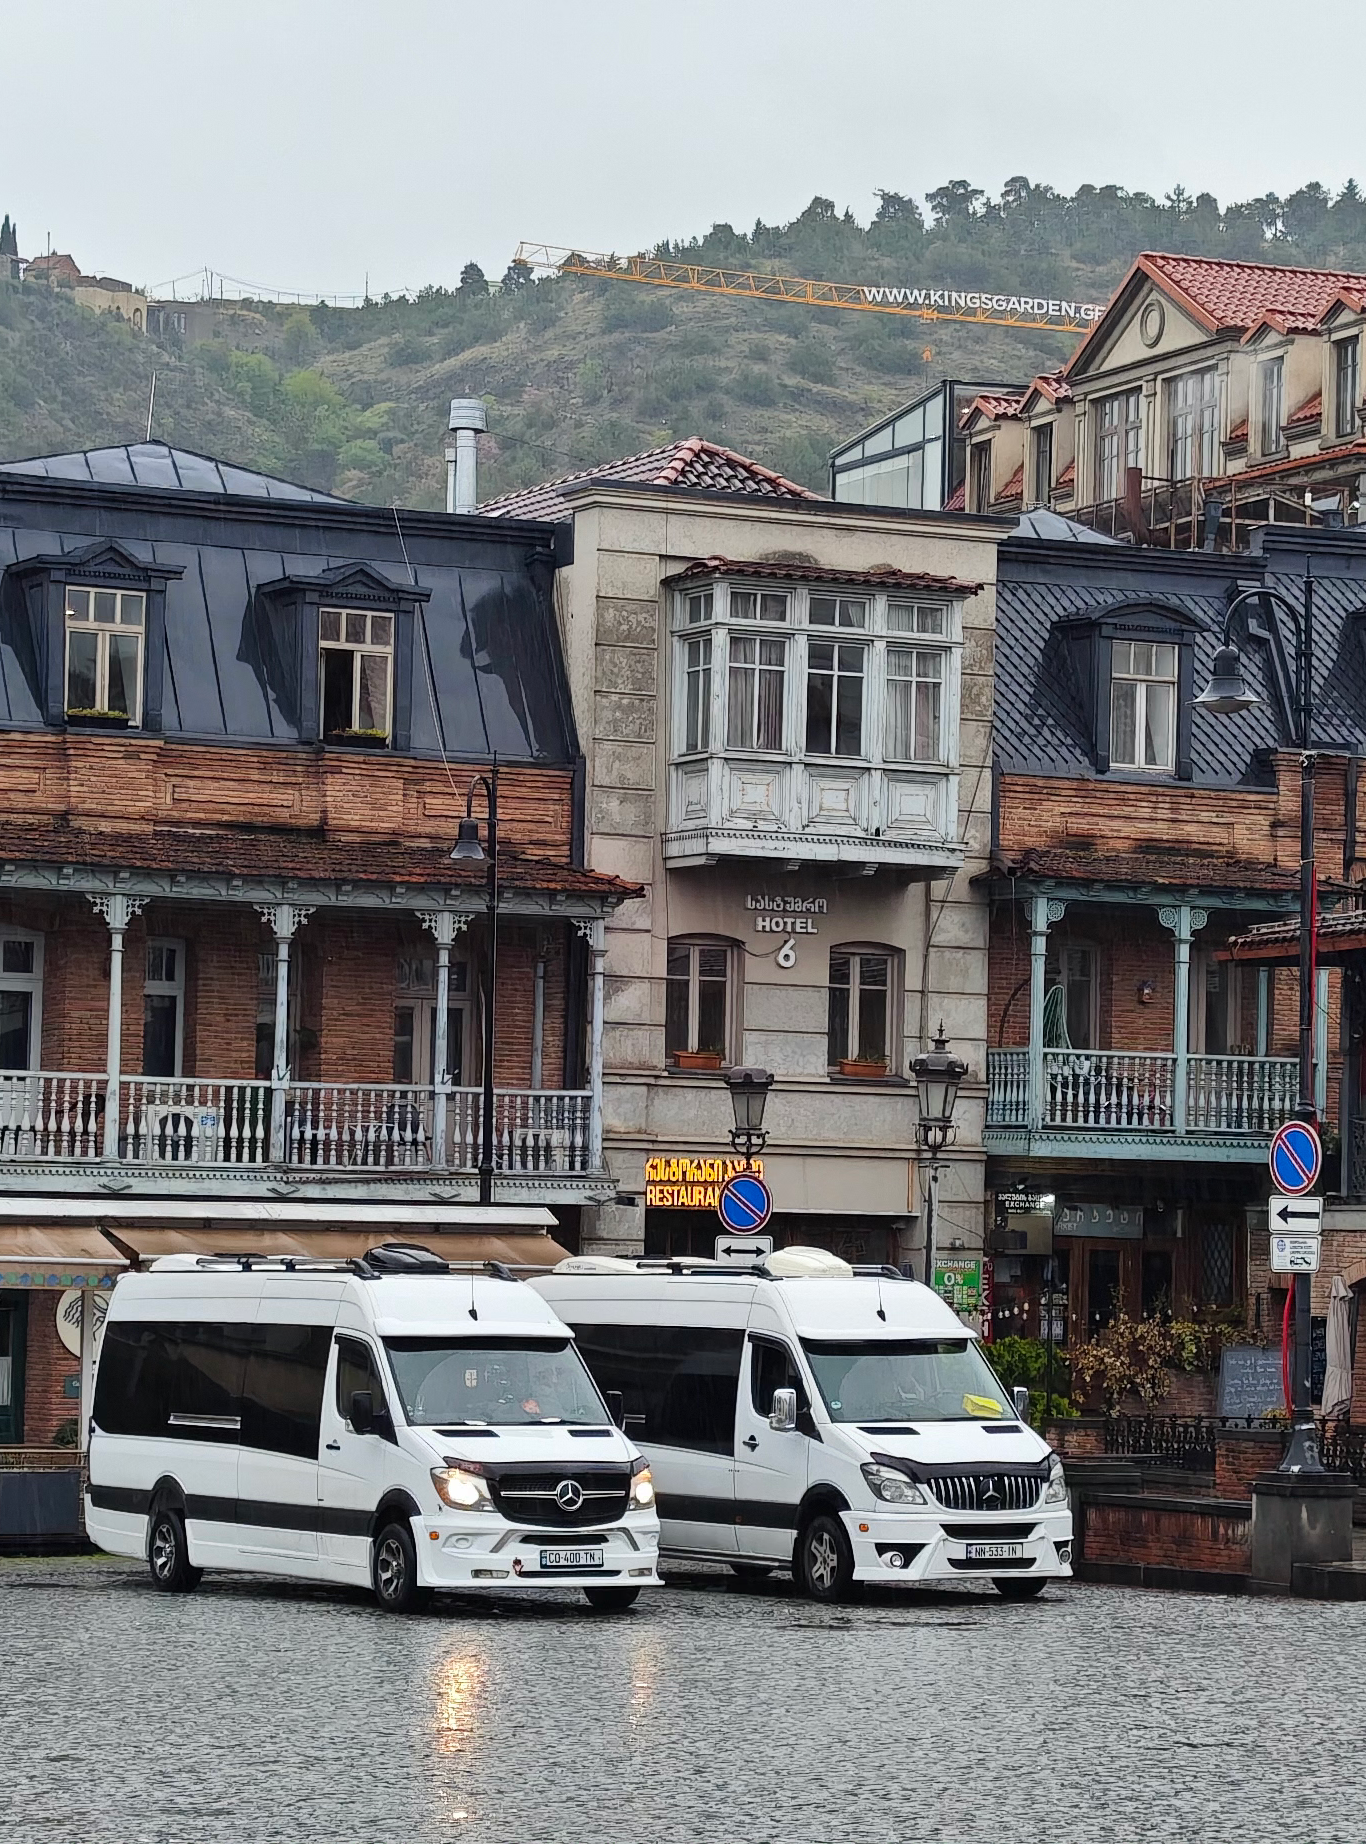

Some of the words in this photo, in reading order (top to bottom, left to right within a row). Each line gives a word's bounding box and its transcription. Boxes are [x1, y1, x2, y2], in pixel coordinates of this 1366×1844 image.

[746, 894, 828, 914] სასტუმრო
[755, 916, 818, 934] HOTEL
[777, 938, 796, 969] 6
[645, 1158, 723, 1182] რესტორანი
[1005, 1201, 1046, 1209] EXCHANGE
[975, 1546, 1017, 1557] NN-533-IN
